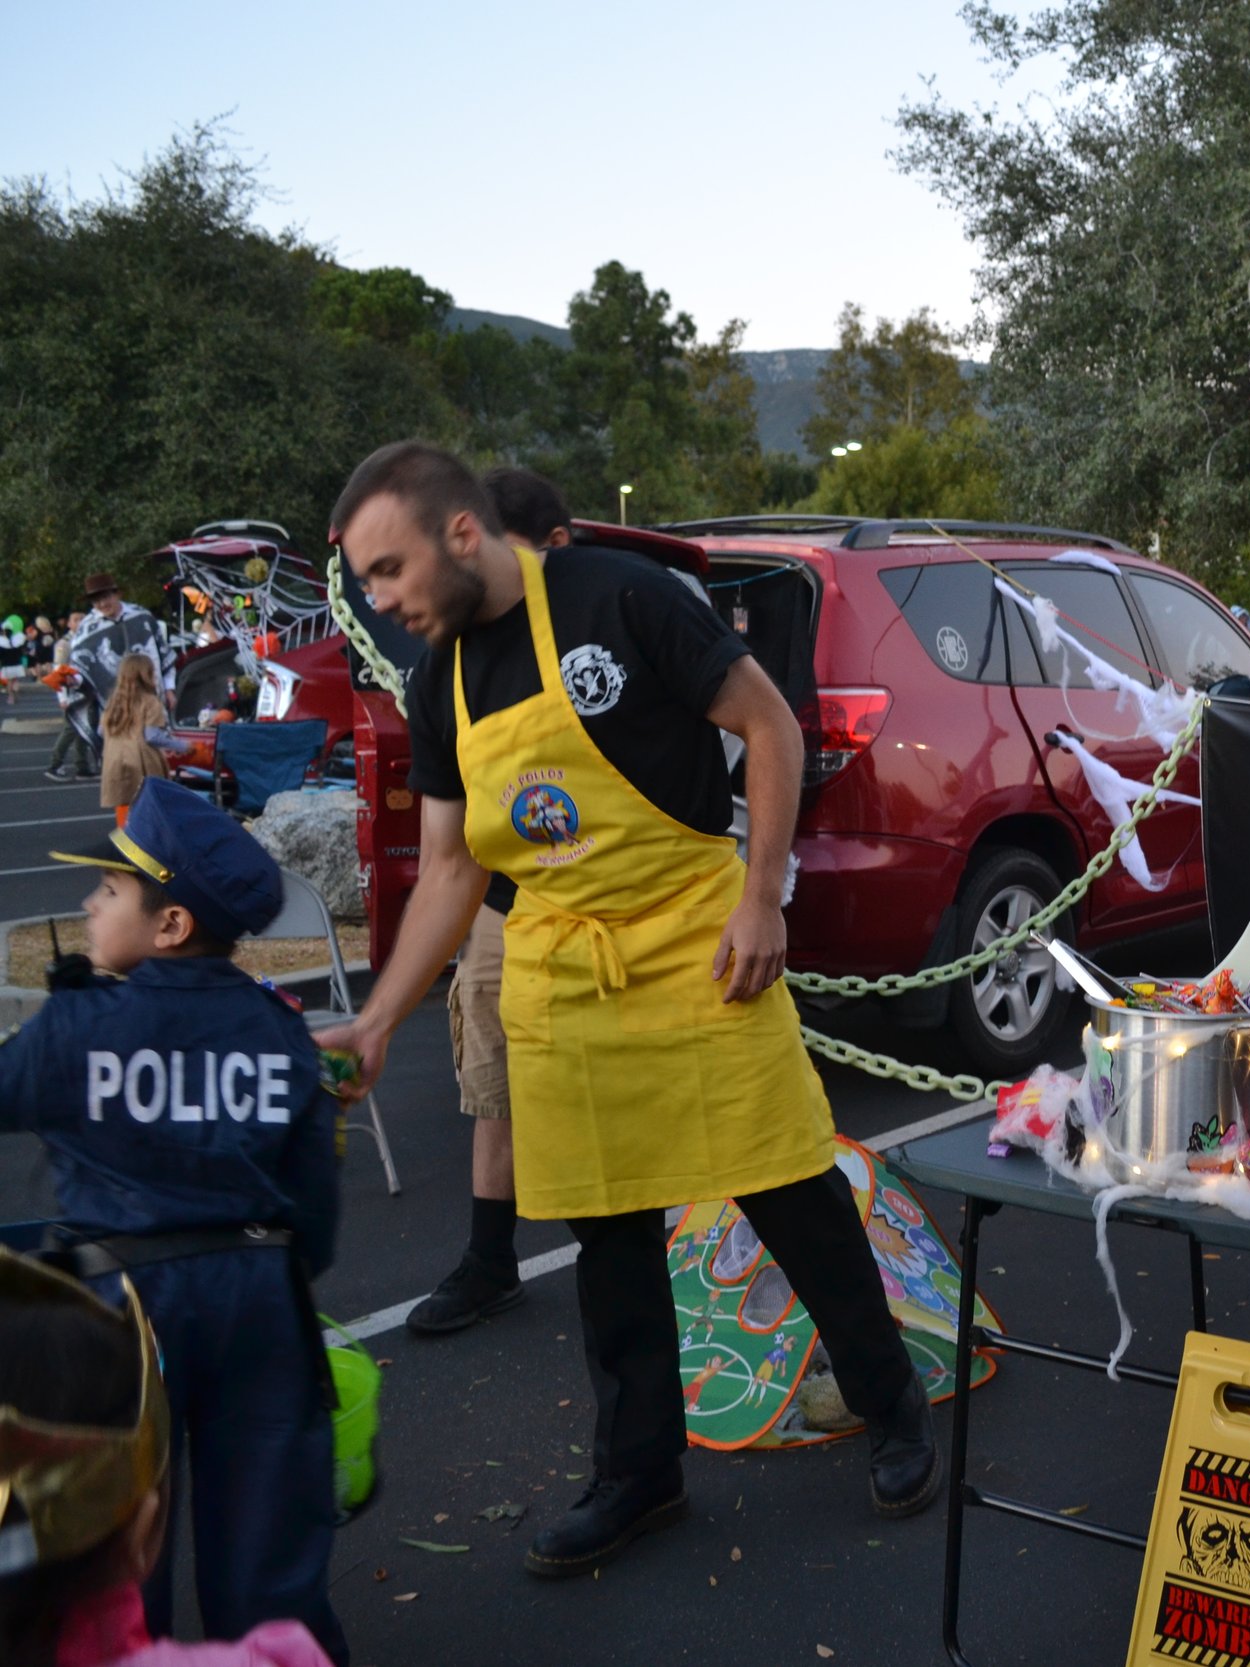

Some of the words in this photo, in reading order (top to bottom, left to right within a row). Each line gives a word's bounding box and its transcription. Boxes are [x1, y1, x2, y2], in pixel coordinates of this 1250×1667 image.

[498, 783, 516, 808] LOS
[518, 768, 564, 786] POLLOS
[384, 846, 419, 857] TOYO
[87, 1048, 291, 1123] POLICE
